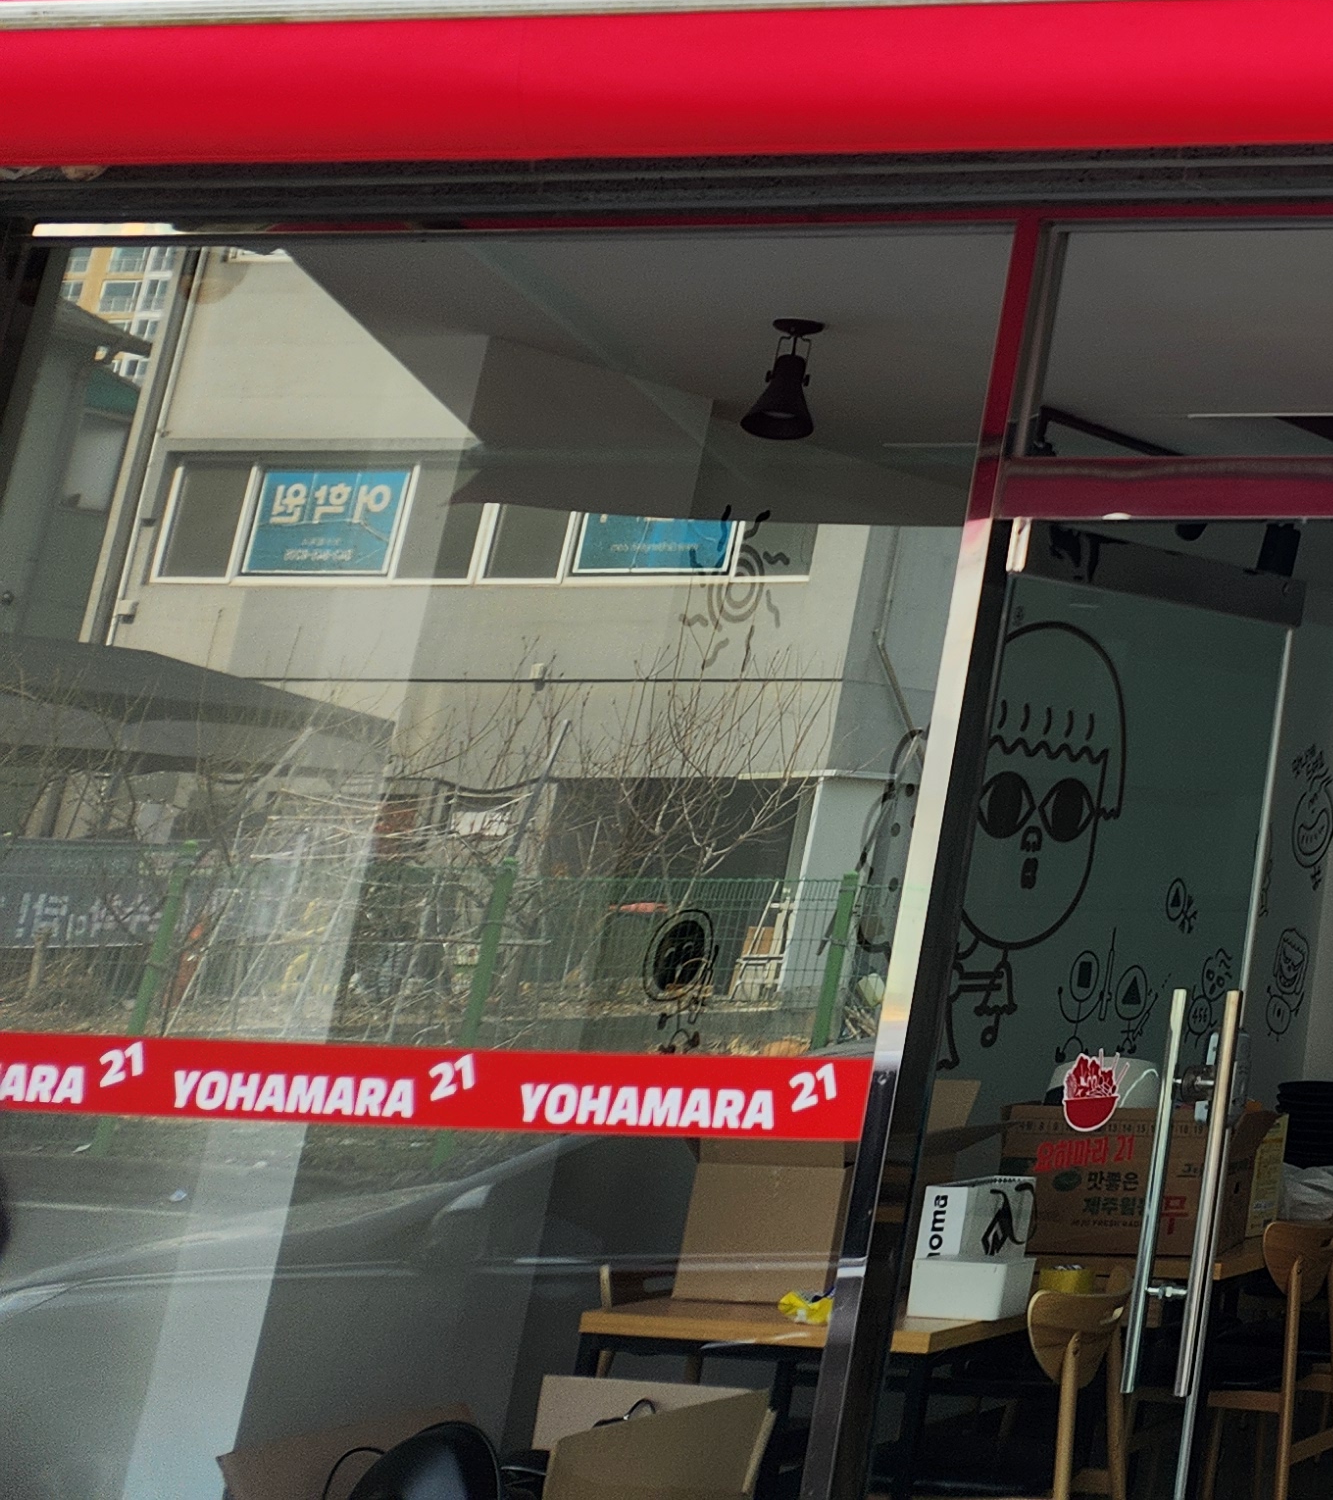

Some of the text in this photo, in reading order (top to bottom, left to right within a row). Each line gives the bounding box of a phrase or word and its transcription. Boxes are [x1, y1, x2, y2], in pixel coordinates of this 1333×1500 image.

[98, 1041, 144, 1088] 21
[173, 1053, 476, 1119] YOHAMARA 21
[520, 1063, 838, 1131] YOHAMARA 21
[1034, 1134, 1136, 1173] 요하마라 21
